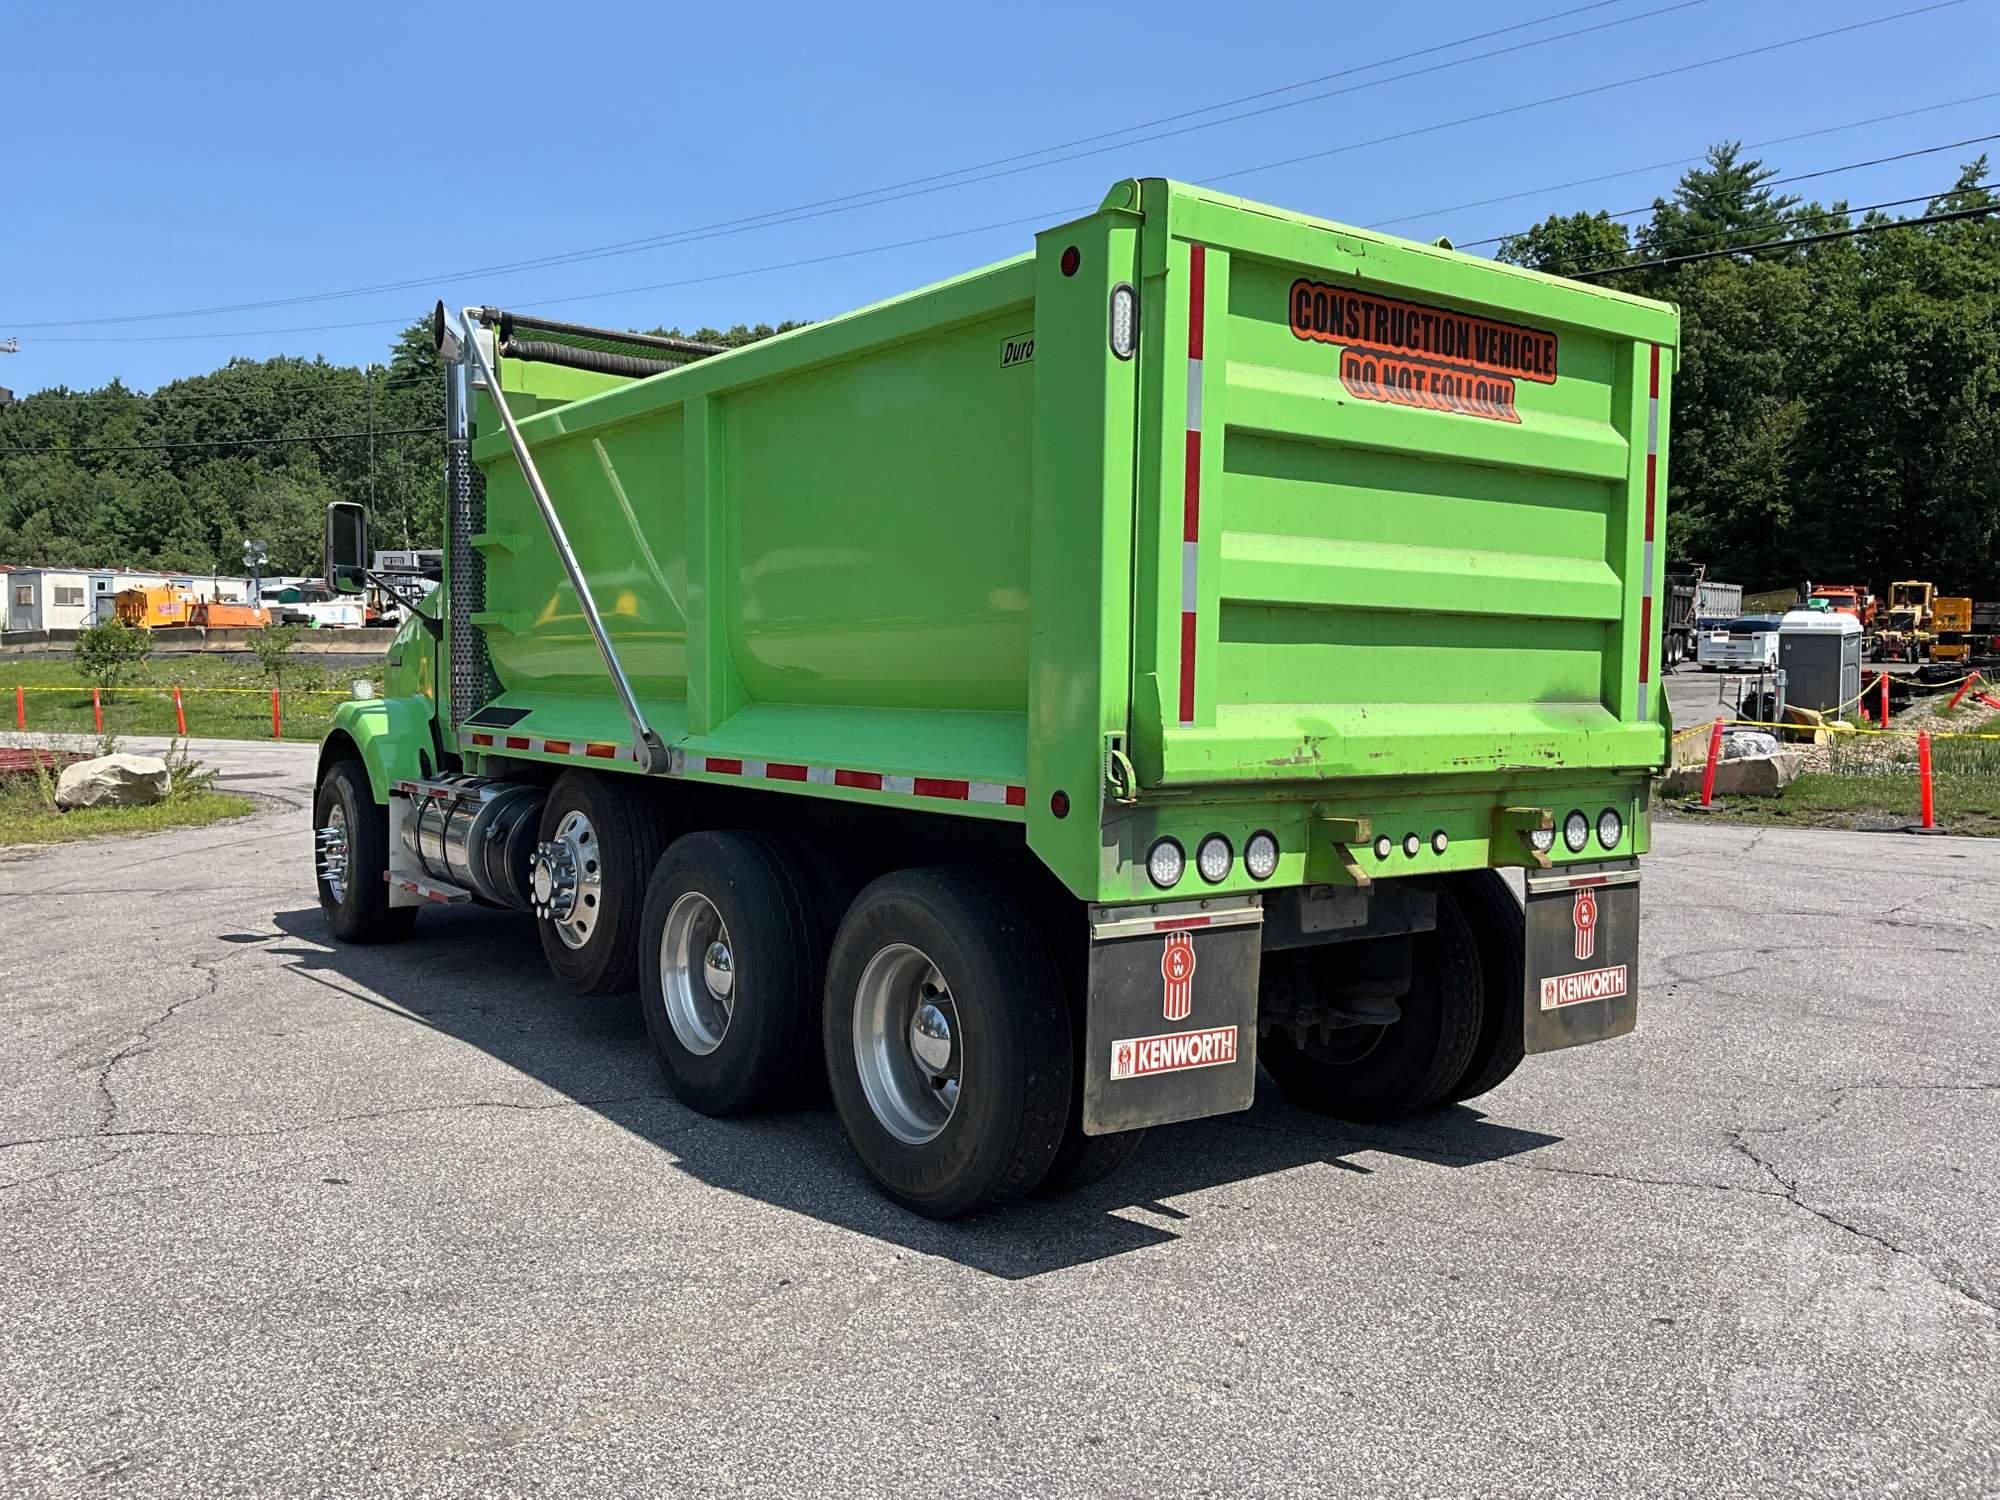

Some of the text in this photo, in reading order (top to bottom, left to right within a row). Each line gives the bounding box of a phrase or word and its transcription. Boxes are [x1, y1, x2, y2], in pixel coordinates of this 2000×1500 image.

[1003, 340, 1034, 364] Duro
[1296, 287, 1554, 377] CONSTRUCTION VEHICLE
[1346, 357, 1514, 418] DO NOT FOLLOW
[1558, 967, 1624, 1003] KENWORTH
[1138, 1031, 1234, 1072] KENWORTH
